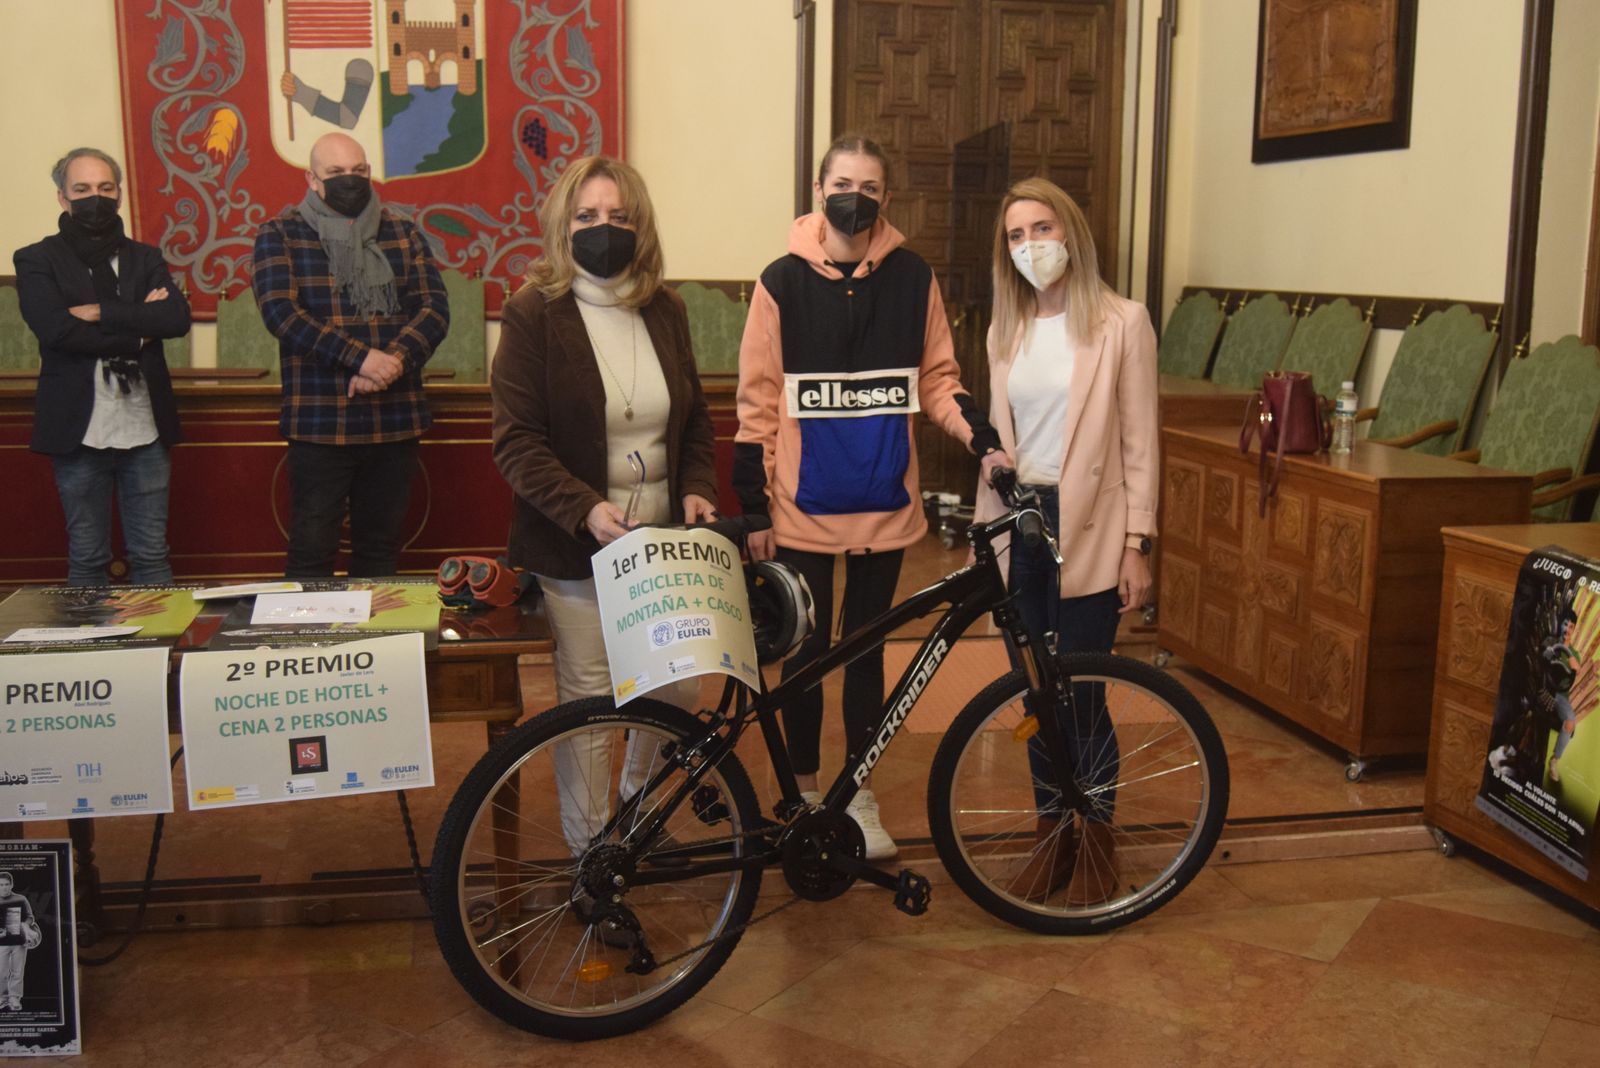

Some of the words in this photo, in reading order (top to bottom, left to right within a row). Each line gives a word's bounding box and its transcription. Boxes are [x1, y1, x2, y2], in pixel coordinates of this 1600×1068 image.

[800, 382, 906, 408] ellesse
[611, 552, 639, 580] 1er
[644, 541, 732, 571] PREMIO
[628, 572, 705, 600] BICICLETA
[708, 574, 725, 591] DE
[616, 594, 688, 634] MONTAÑA
[692, 597, 703, 608] +
[707, 596, 742, 622] CASCO
[675, 617, 710, 630] GRUPO
[677, 628, 711, 640] EULEN
[265, 651, 374, 678] PREMIO
[6, 679, 112, 705] PREMIO
[214, 691, 280, 712] NOCHE
[286, 689, 309, 705] DE
[315, 683, 373, 702] HOTEL
[378, 684, 388, 695] +
[6, 718, 17, 733] 2
[22, 713, 116, 732] PERSONAS
[219, 718, 269, 737] CENA
[275, 717, 285, 732] 2
[291, 707, 388, 731] PERSONAS
[853, 638, 948, 788] ROCKRIDER
[394, 764, 419, 773] EULEN
[124, 792, 148, 801] EULEN
